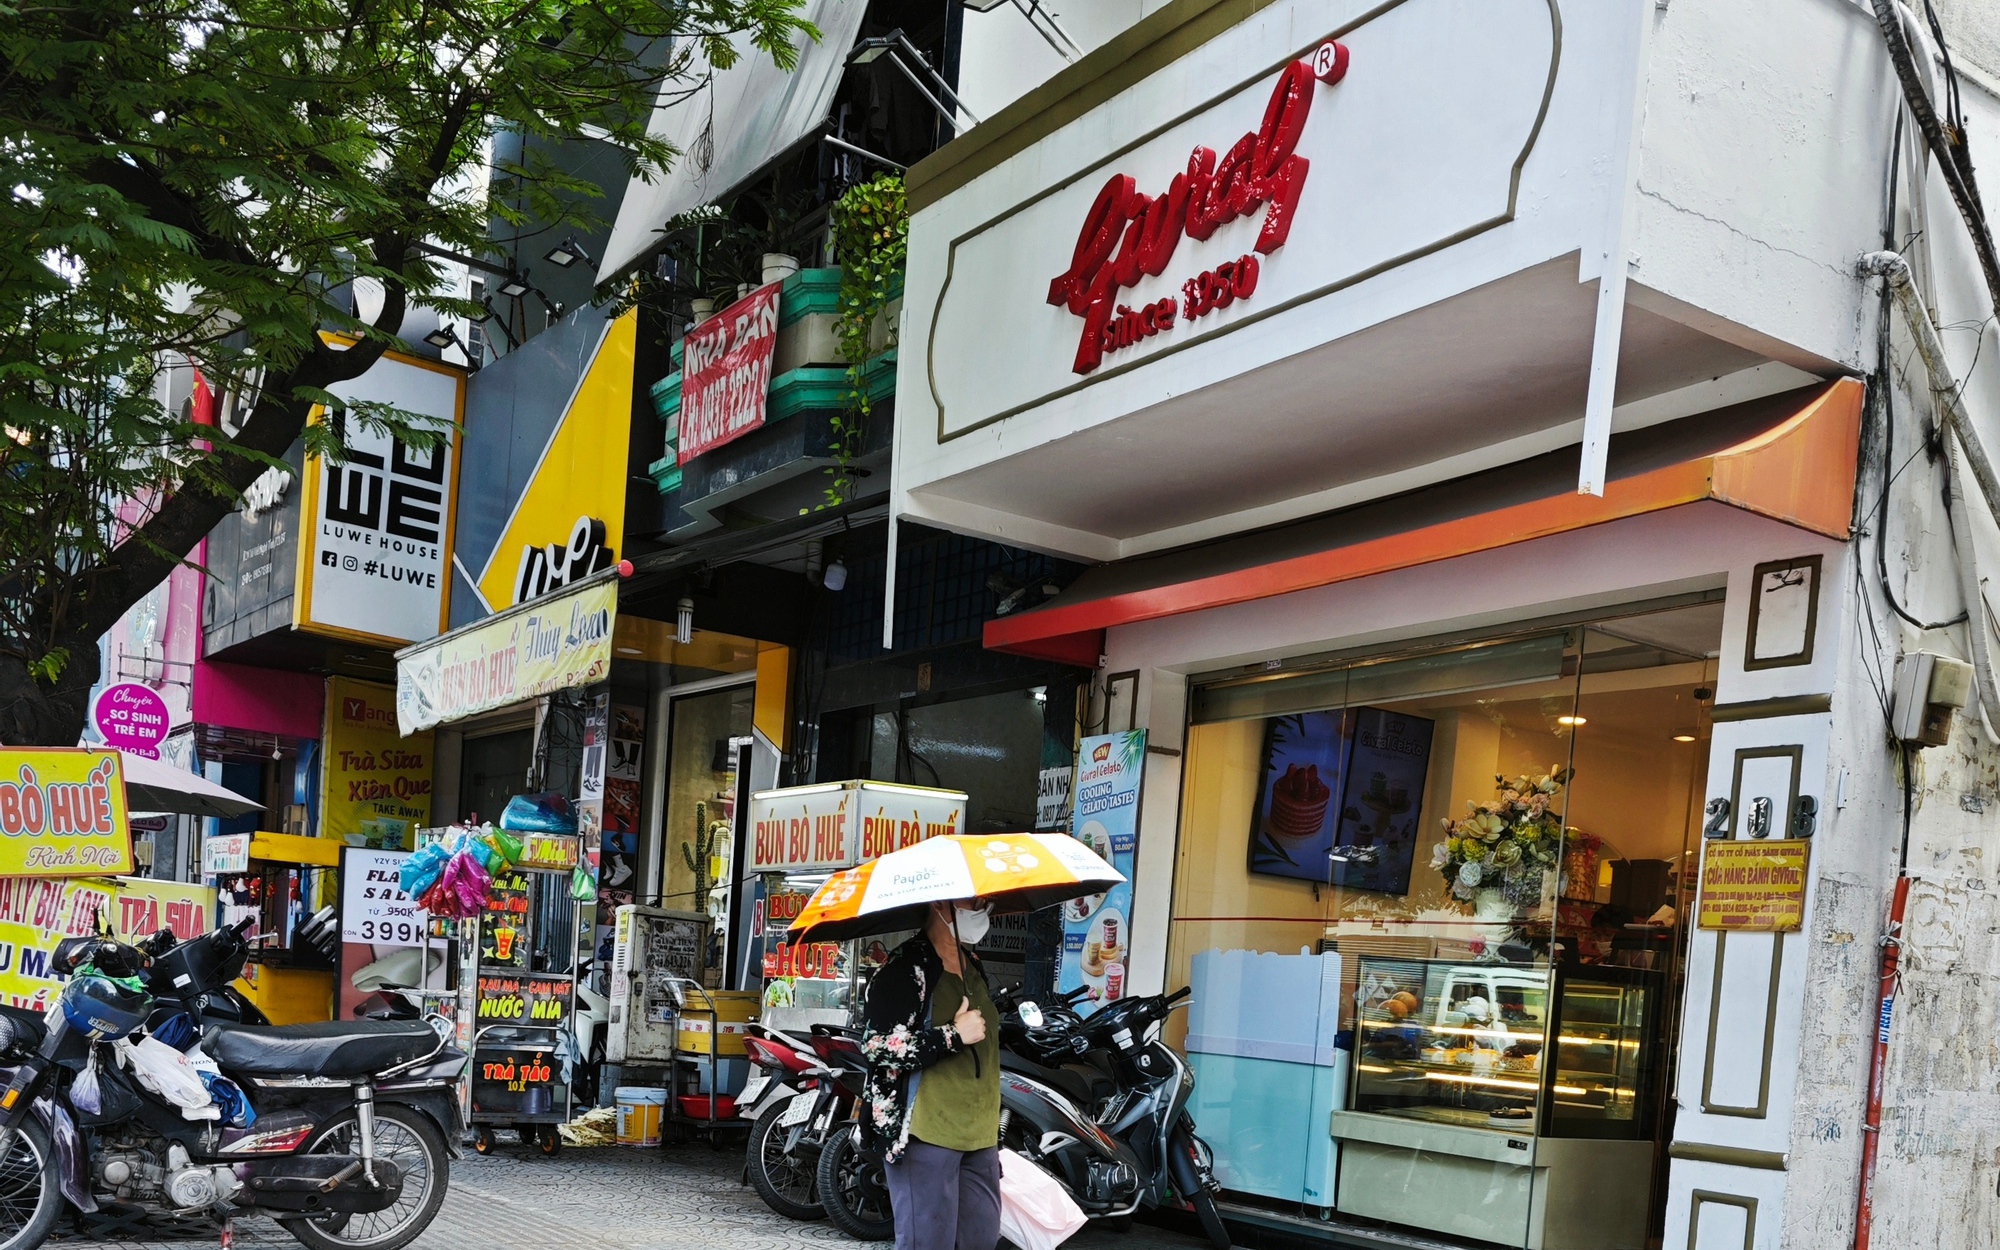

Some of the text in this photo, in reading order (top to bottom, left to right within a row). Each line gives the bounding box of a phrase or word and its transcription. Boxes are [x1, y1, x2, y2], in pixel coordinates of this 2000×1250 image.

[1102, 254, 1259, 354] since 1950
[685, 293, 780, 379] NHÀ BÁN
[700, 375, 727, 445] 0937
[728, 359, 760, 432] 2222
[323, 524, 438, 560] LUWE HOUSE
[364, 560, 436, 589] #LUWE
[467, 644, 487, 705] BÒ
[488, 622, 520, 700] HUẾ
[525, 616, 561, 662] Thùy
[113, 687, 153, 709] Chuyên
[110, 709, 162, 725] SƠ SINH
[114, 723, 135, 735] TRẺ
[139, 727, 157, 738] EM
[339, 749, 423, 771] Trà Sữa
[1094, 745, 1110, 760] NEW
[1100, 761, 1122, 777] Gelato
[0, 758, 114, 835] BÒ HUẾ
[349, 776, 431, 802] Xiên Que
[1080, 782, 1112, 801] COOLING
[373, 803, 425, 819] TAKE AWAY
[1082, 790, 1134, 815] GELATO TASTES
[755, 794, 849, 865] BÚN BÒ HUẾ
[863, 807, 895, 858] BÚN
[25, 846, 76, 868] Kính
[374, 857, 390, 865] YZY
[366, 870, 400, 883] FLA
[893, 872, 931, 885] Payoo
[1724, 863, 1745, 885] HÀNG
[1747, 862, 1770, 885] BÁNH
[1771, 866, 1799, 885] GIVRAL
[363, 888, 407, 901] SAL
[119, 895, 204, 940] TRÀ SỮA
[361, 921, 424, 943] 399K
[990, 934, 1004, 948] 0937
[1005, 935, 1020, 950] 2222
[479, 977, 501, 991] RAU
[503, 977, 519, 992] MÁ
[478, 994, 562, 1019] NƯỚC MÍA
[88, 1016, 120, 1034] SHIPPER
[483, 1052, 550, 1082] TRÀ TẮC
